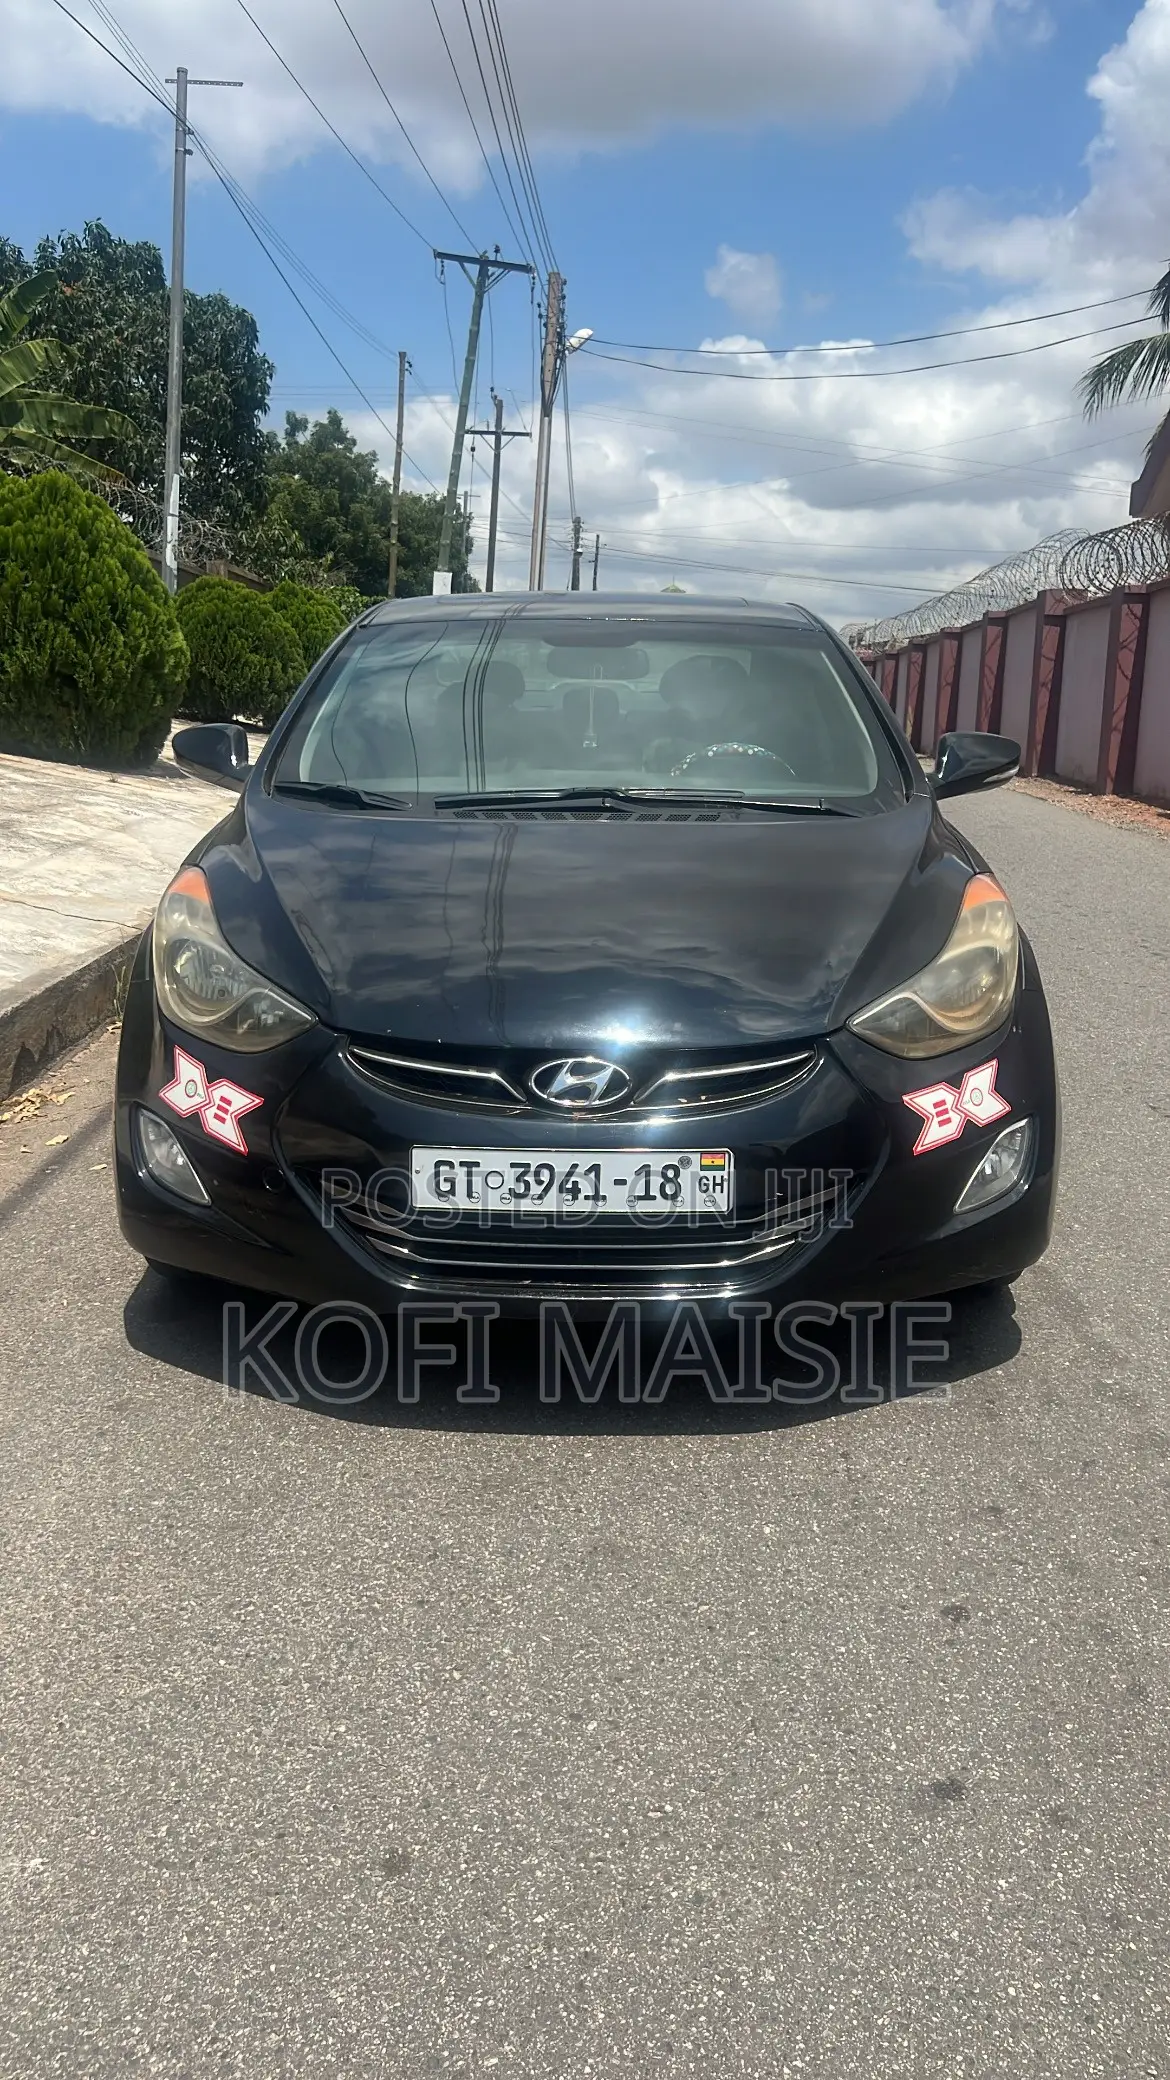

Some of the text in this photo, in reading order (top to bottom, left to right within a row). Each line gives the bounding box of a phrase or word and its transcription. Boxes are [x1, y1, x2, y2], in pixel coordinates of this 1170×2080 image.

[434, 1160, 682, 1201] GT 3941-18
[698, 1175, 725, 1194] GH
